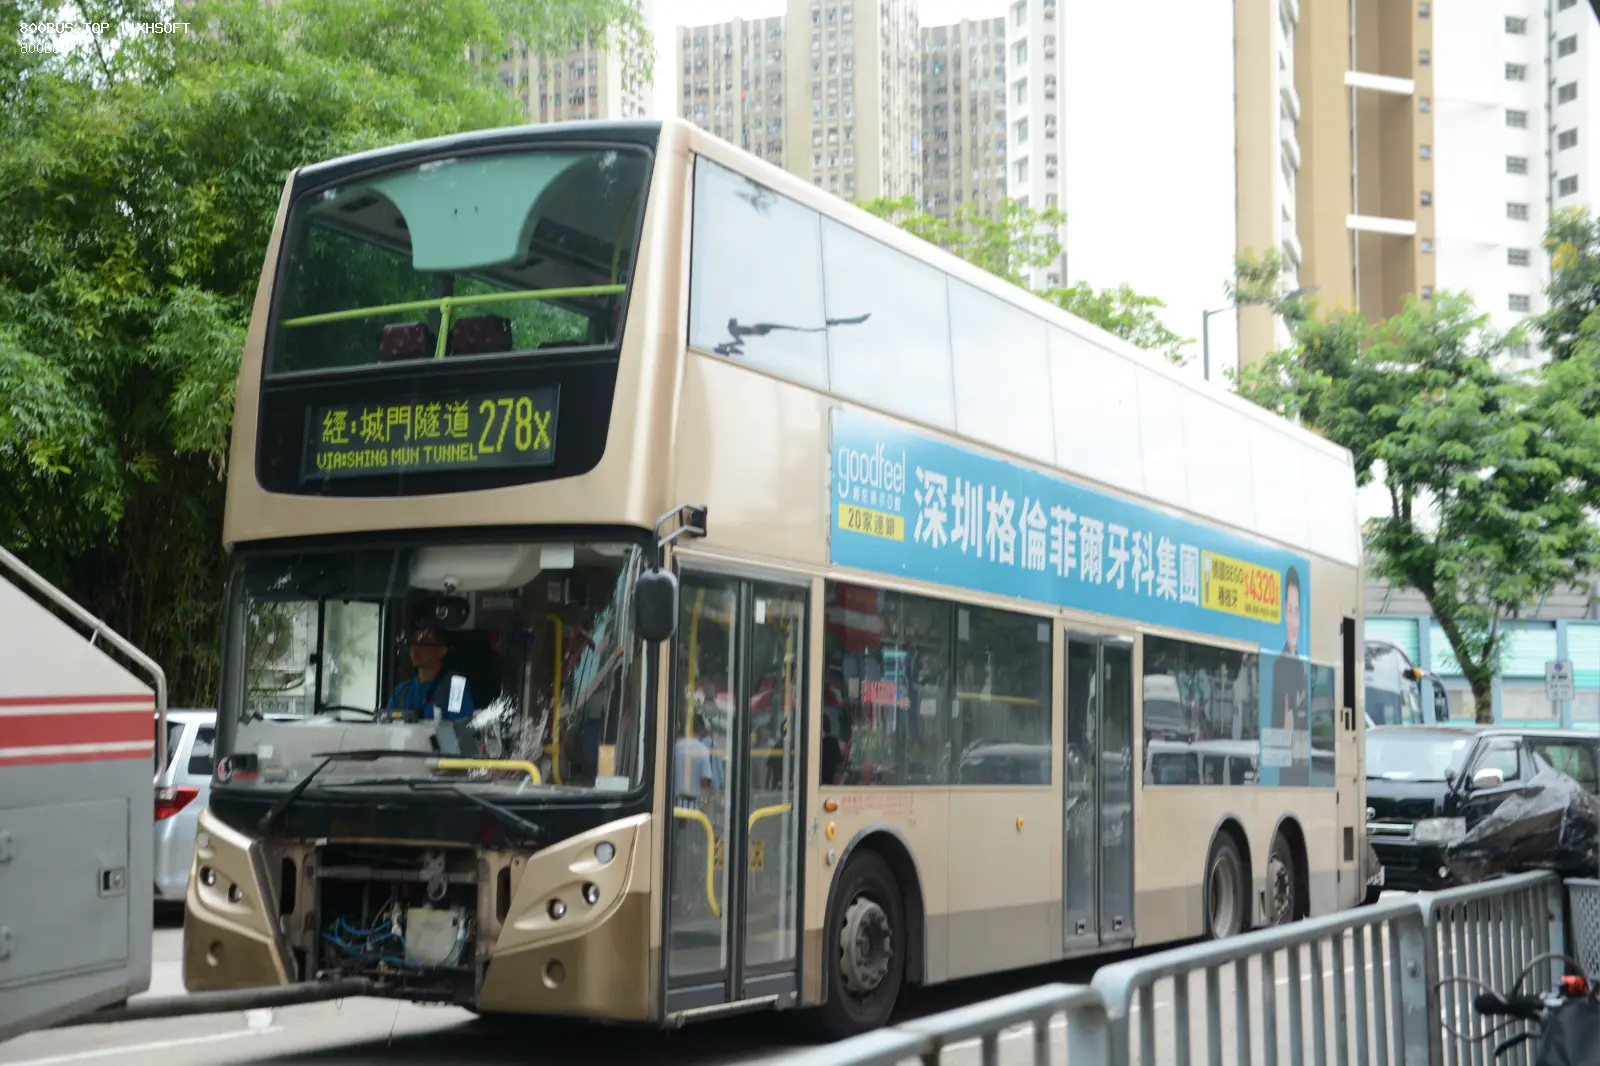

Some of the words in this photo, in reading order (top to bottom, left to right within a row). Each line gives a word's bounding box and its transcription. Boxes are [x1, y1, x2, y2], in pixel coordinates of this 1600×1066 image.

[390, 447, 420, 465] MUN
[422, 442, 478, 462] TUNNEL
[837, 440, 906, 499] goodfeel
[914, 465, 1200, 607] 深圳格倫菲爾牙科集團
